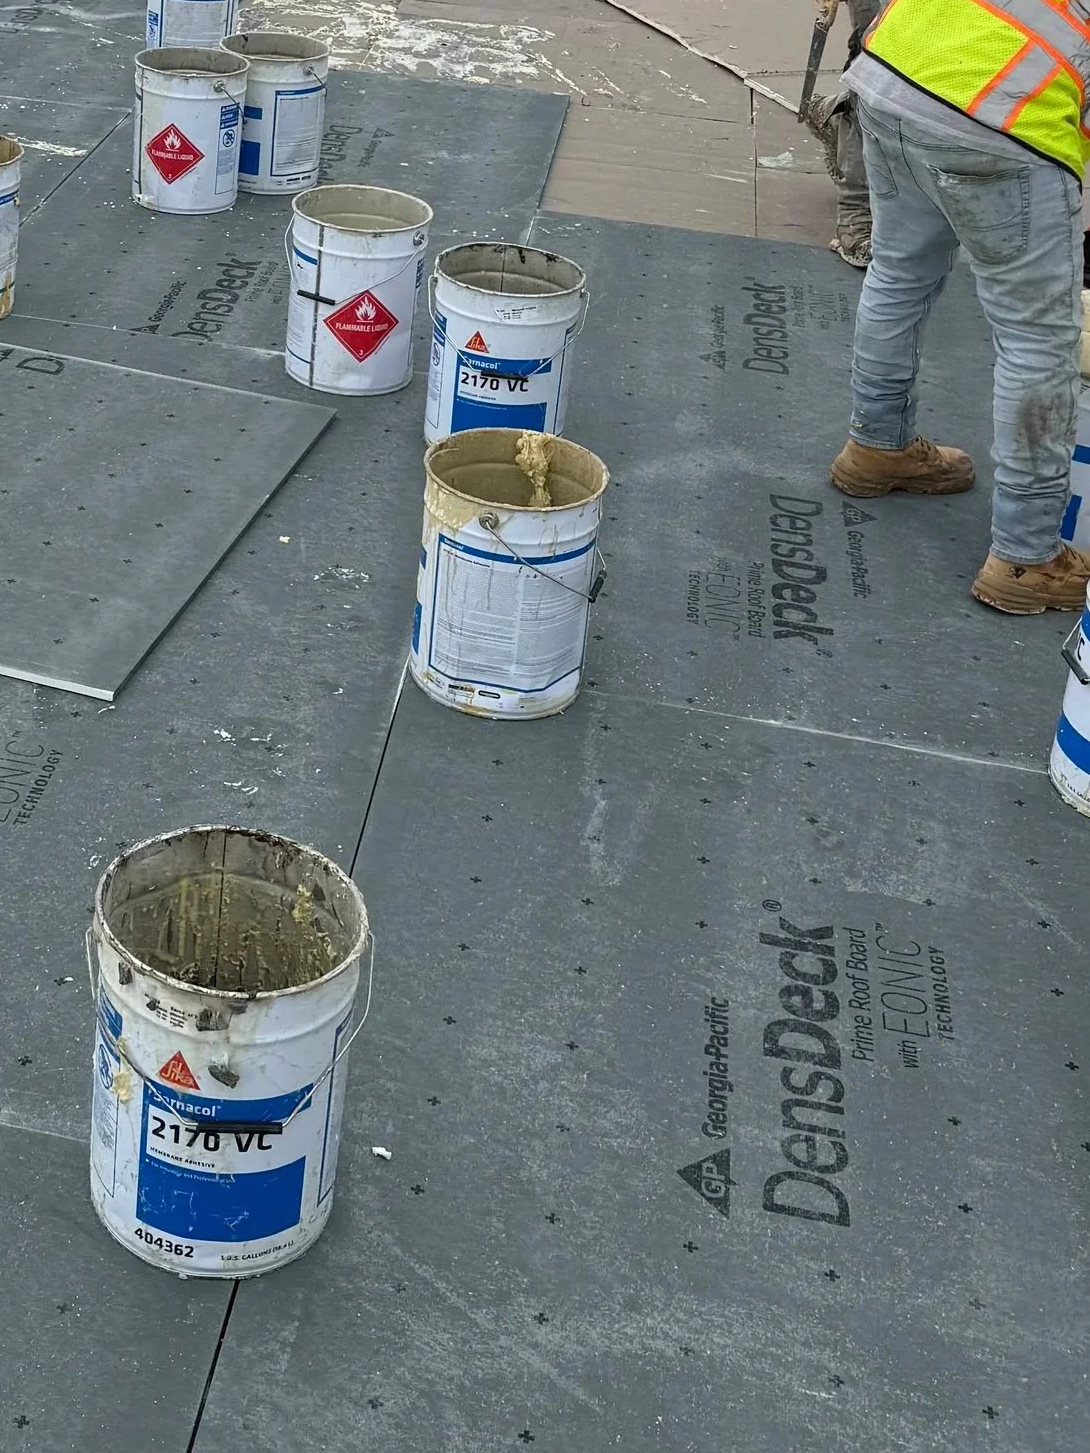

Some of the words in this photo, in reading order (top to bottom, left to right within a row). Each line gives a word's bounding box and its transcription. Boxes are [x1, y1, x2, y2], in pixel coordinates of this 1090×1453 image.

[335, 322, 371, 333] FLAMMABLE
[371, 323, 389, 333] LIQUID
[15, 356, 65, 376] D
[462, 355, 498, 370] Sarnacol
[460, 371, 500, 391] 2170
[507, 377, 529, 392] VC
[13, 748, 64, 829] TECHNOLOGY
[842, 926, 869, 973] Board
[844, 973, 872, 1014] Roof
[928, 945, 956, 1042] TECHNOLOGY
[851, 1014, 875, 1063] Prime
[701, 996, 735, 1140] Georgia-Pacific
[896, 1040, 920, 1070] with
[160, 1060, 195, 1087] Sika
[153, 1089, 217, 1117] Sarnacol
[151, 1115, 220, 1153] 2170
[232, 1131, 273, 1153] VC
[150, 1146, 183, 1162] MEMBRANE
[184, 1158, 216, 1169] ADHESIVE
[701, 1162, 724, 1198] GP
[134, 1227, 195, 1259] 404362
